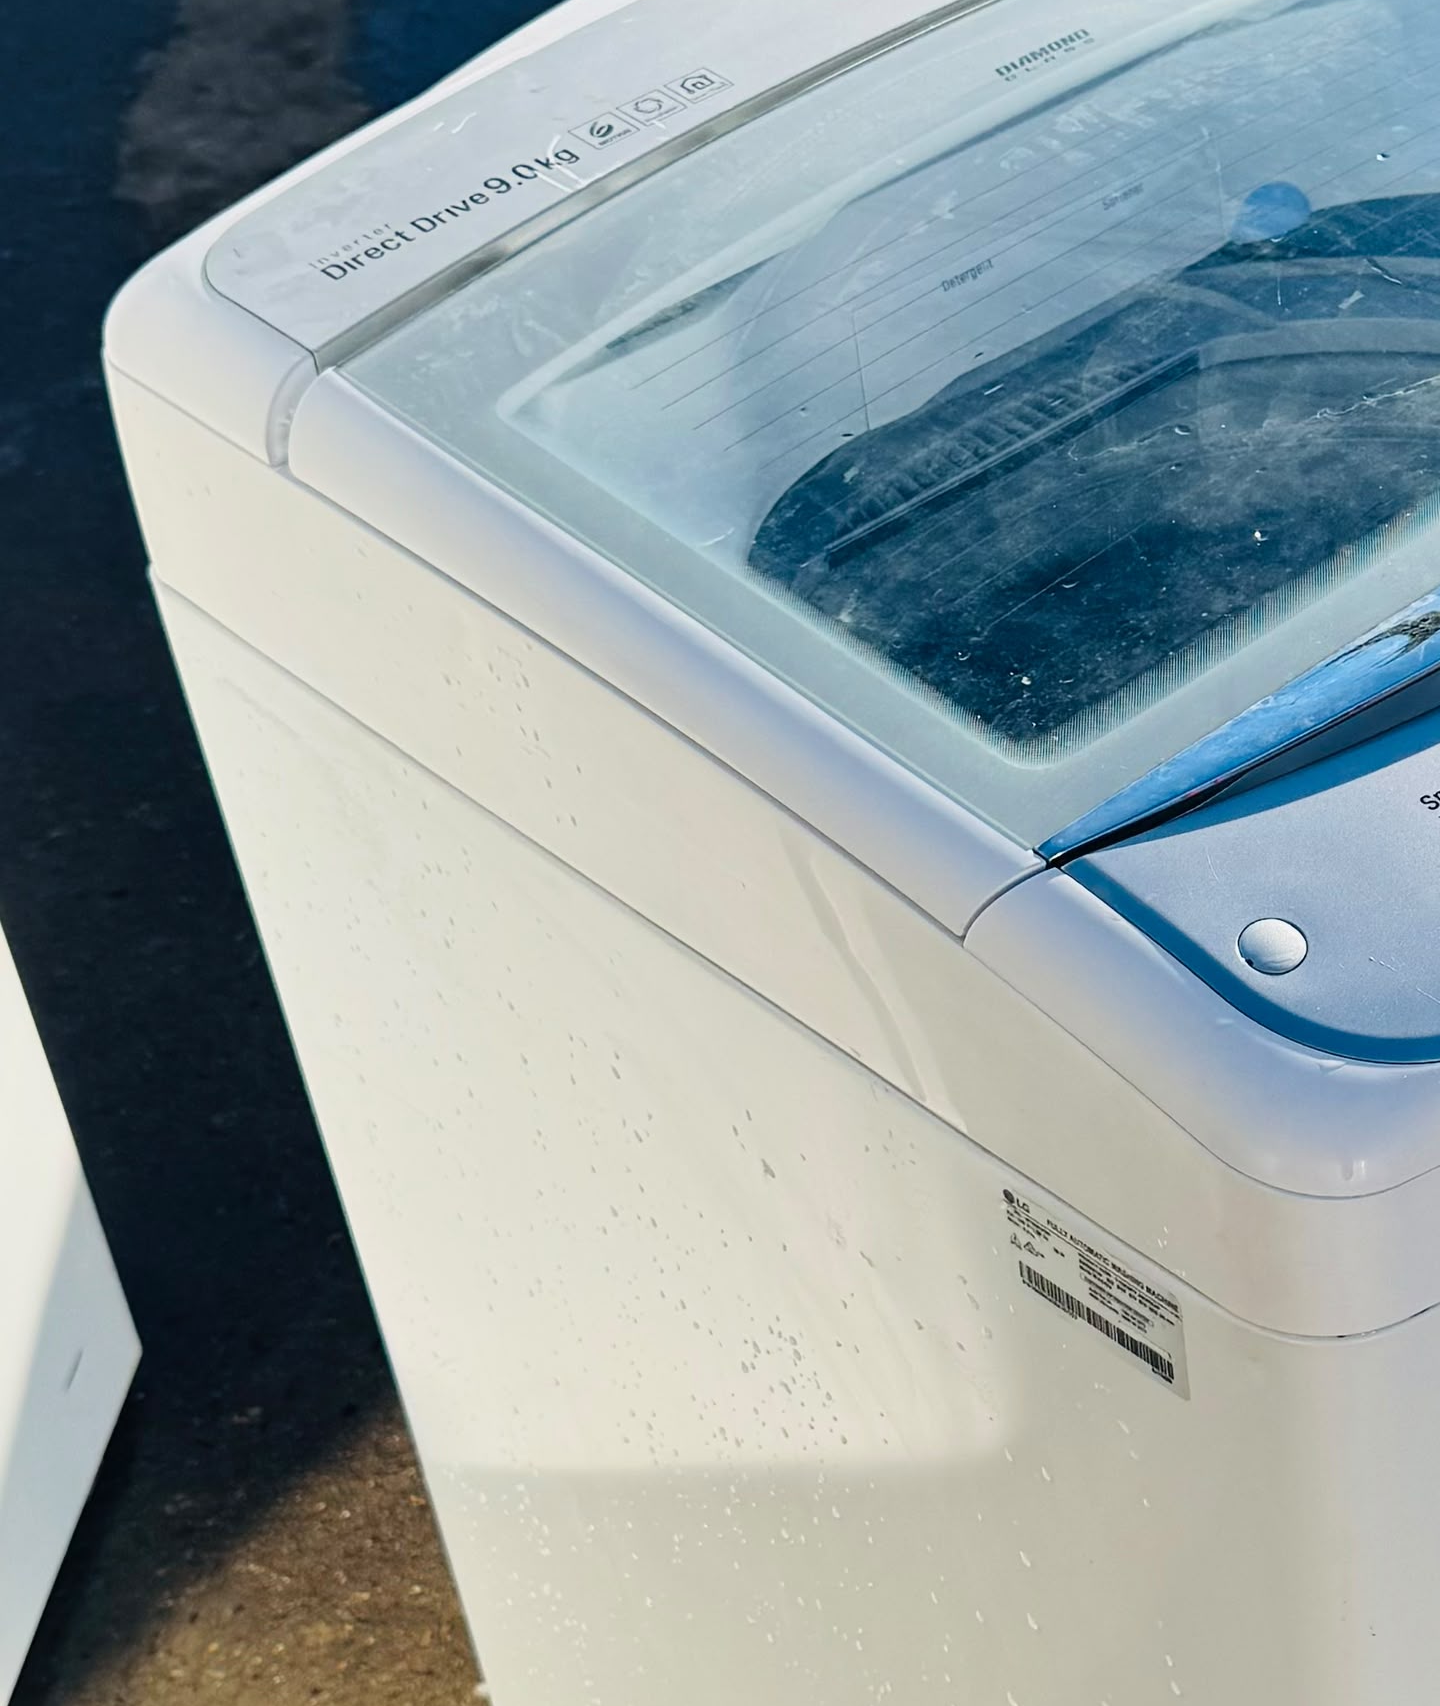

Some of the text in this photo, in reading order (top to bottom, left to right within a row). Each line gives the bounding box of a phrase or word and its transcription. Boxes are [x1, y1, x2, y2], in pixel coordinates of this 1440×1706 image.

[995, 28, 1090, 76] DIAMOND
[320, 149, 580, 281] Direct Drive 9.0 kg
[308, 223, 393, 269] Inverter
[941, 258, 994, 293] Detergent
[1016, 1197, 1030, 1214] LG
